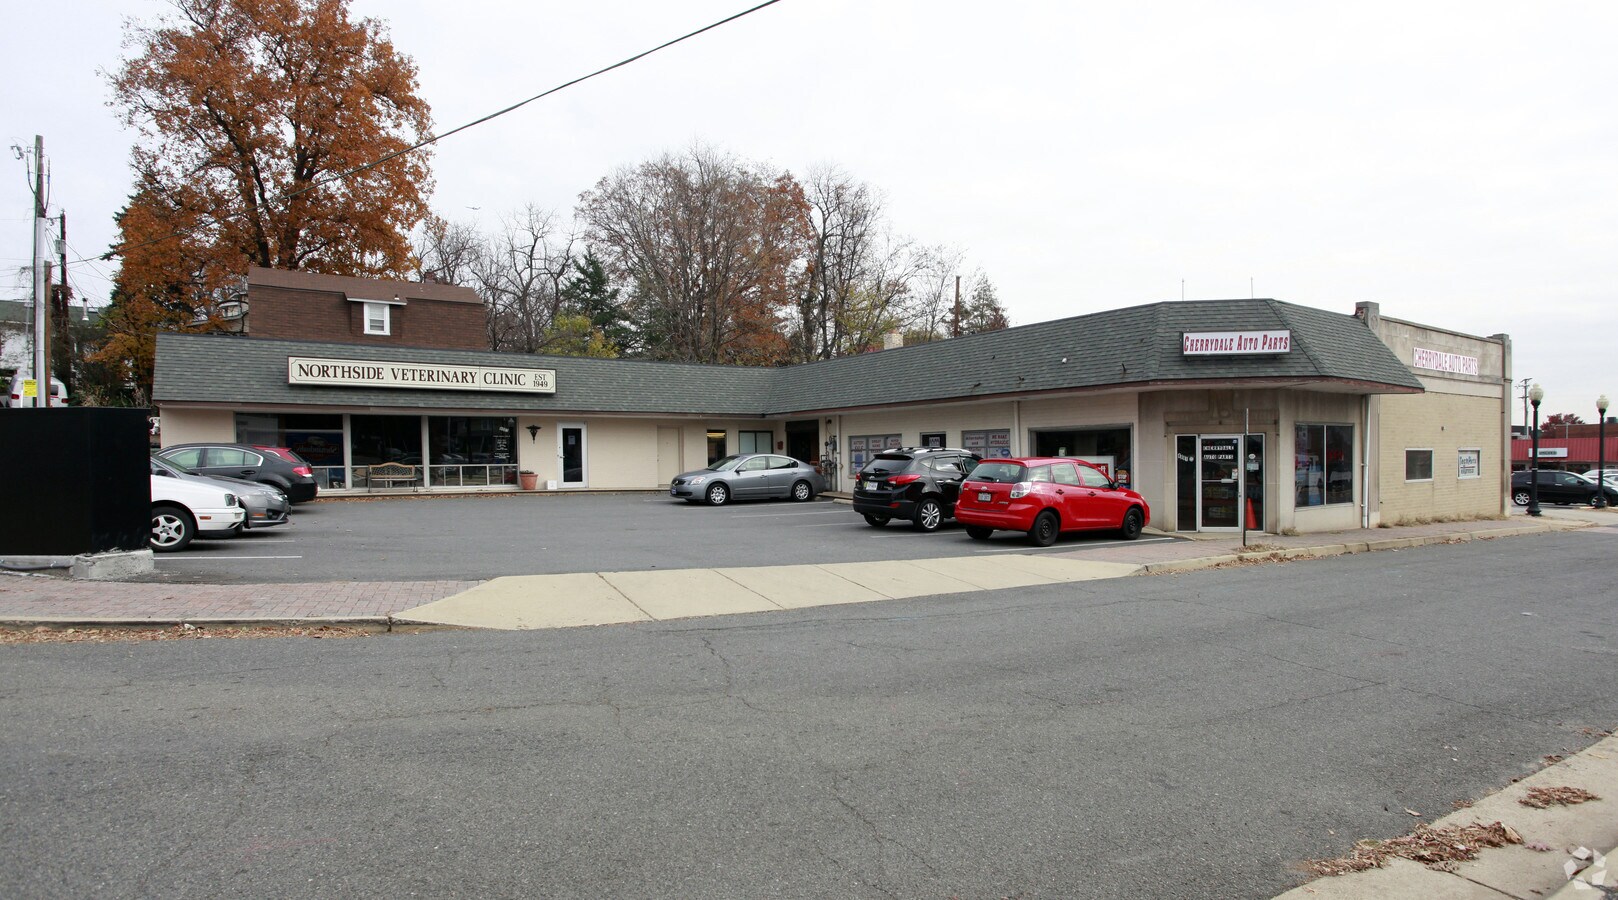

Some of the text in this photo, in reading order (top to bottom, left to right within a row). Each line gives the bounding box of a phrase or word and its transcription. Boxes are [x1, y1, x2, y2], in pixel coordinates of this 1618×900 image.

[1184, 334, 1289, 352] CHERRYDALE AUTO PARTS
[1414, 348, 1477, 375] CHERRYDALE AUTO PARTS
[298, 363, 526, 386] NORTHSIDE VETERINARY CLINIC
